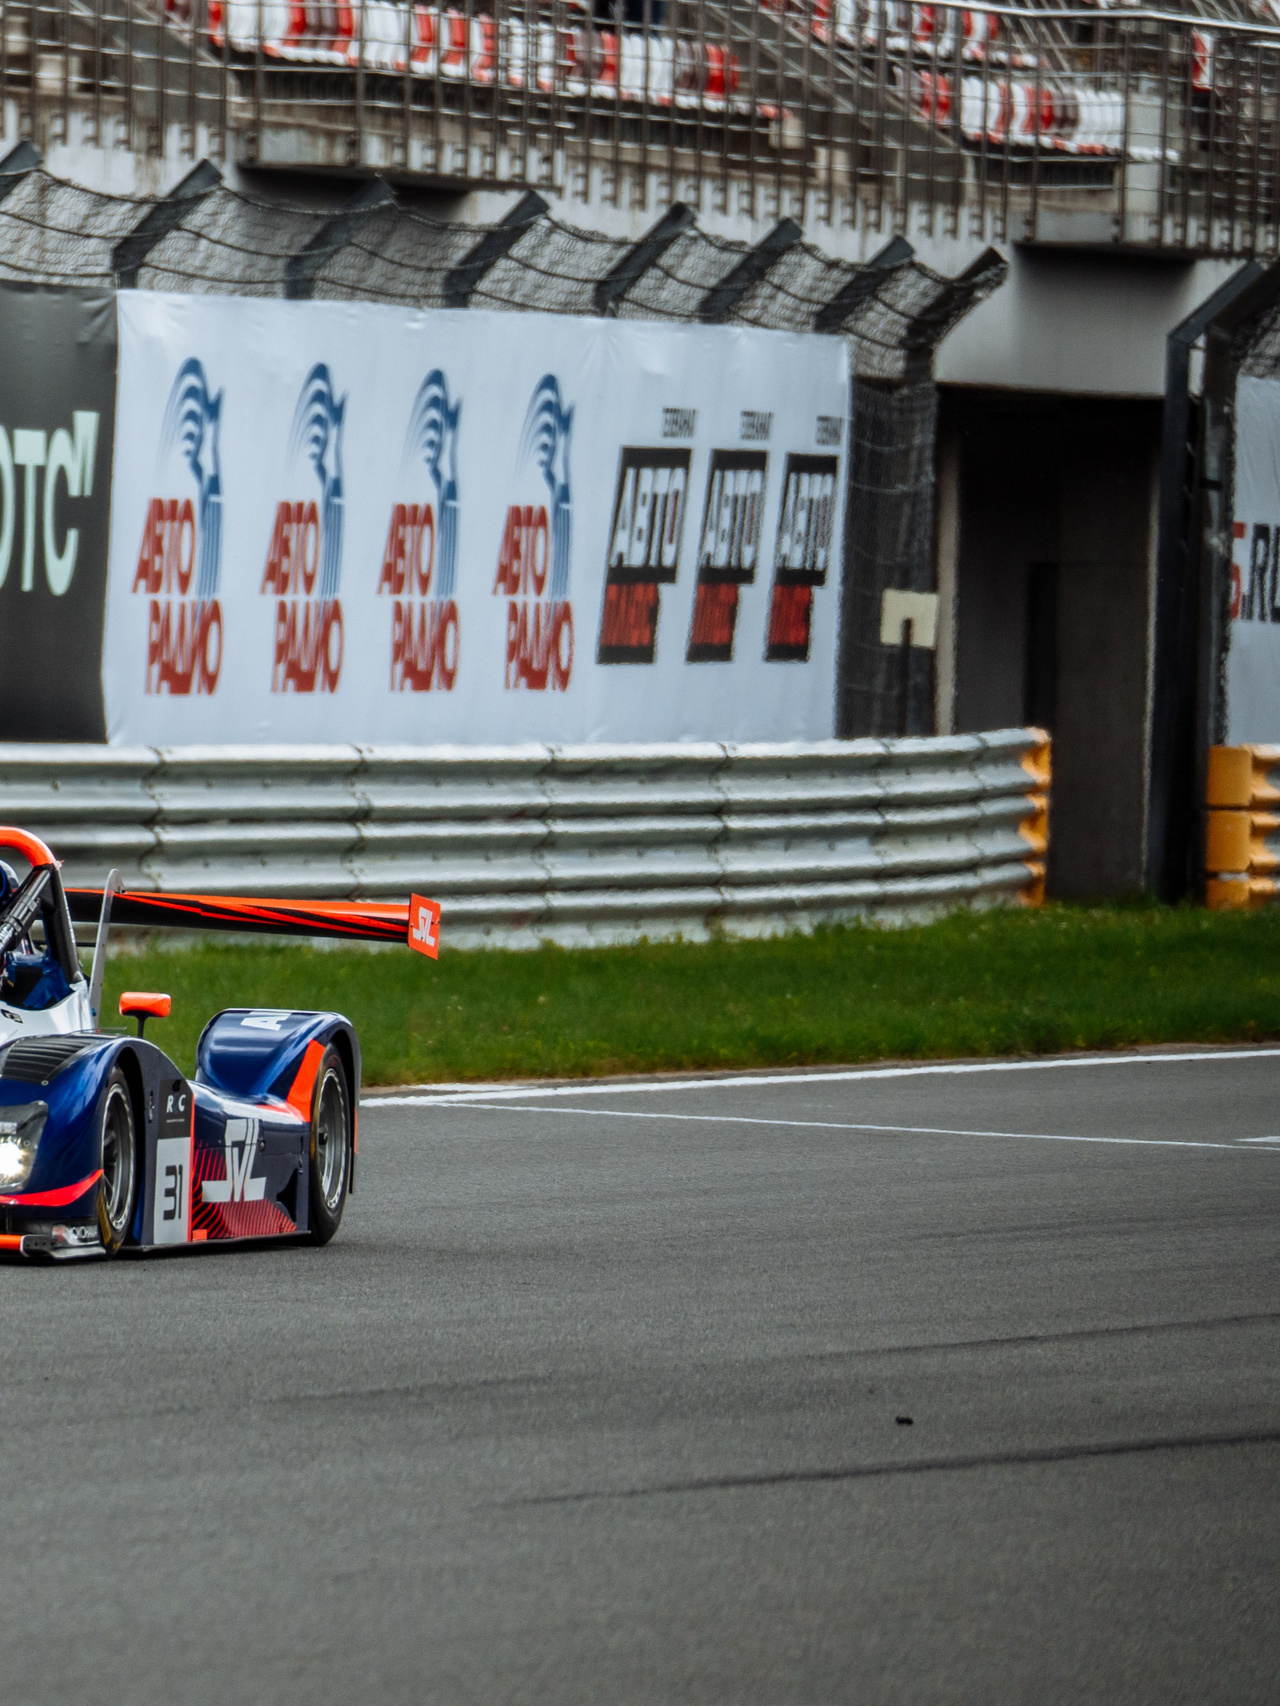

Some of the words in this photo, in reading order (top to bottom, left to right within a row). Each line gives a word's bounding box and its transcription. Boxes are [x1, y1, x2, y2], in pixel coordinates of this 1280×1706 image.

[131, 498, 196, 596] АВТО
[260, 500, 319, 596] АВТО
[377, 503, 435, 596] АВТО
[492, 505, 548, 596] АВТО
[608, 466, 688, 568] АВТО
[698, 469, 766, 568] АВТО
[776, 472, 835, 569] АВТО
[145, 599, 223, 695] РАДИО
[271, 599, 344, 693] РАДИО
[389, 600, 459, 692] РАДИО
[505, 600, 574, 692] РАДИО
[163, 1164, 183, 1221] 31
